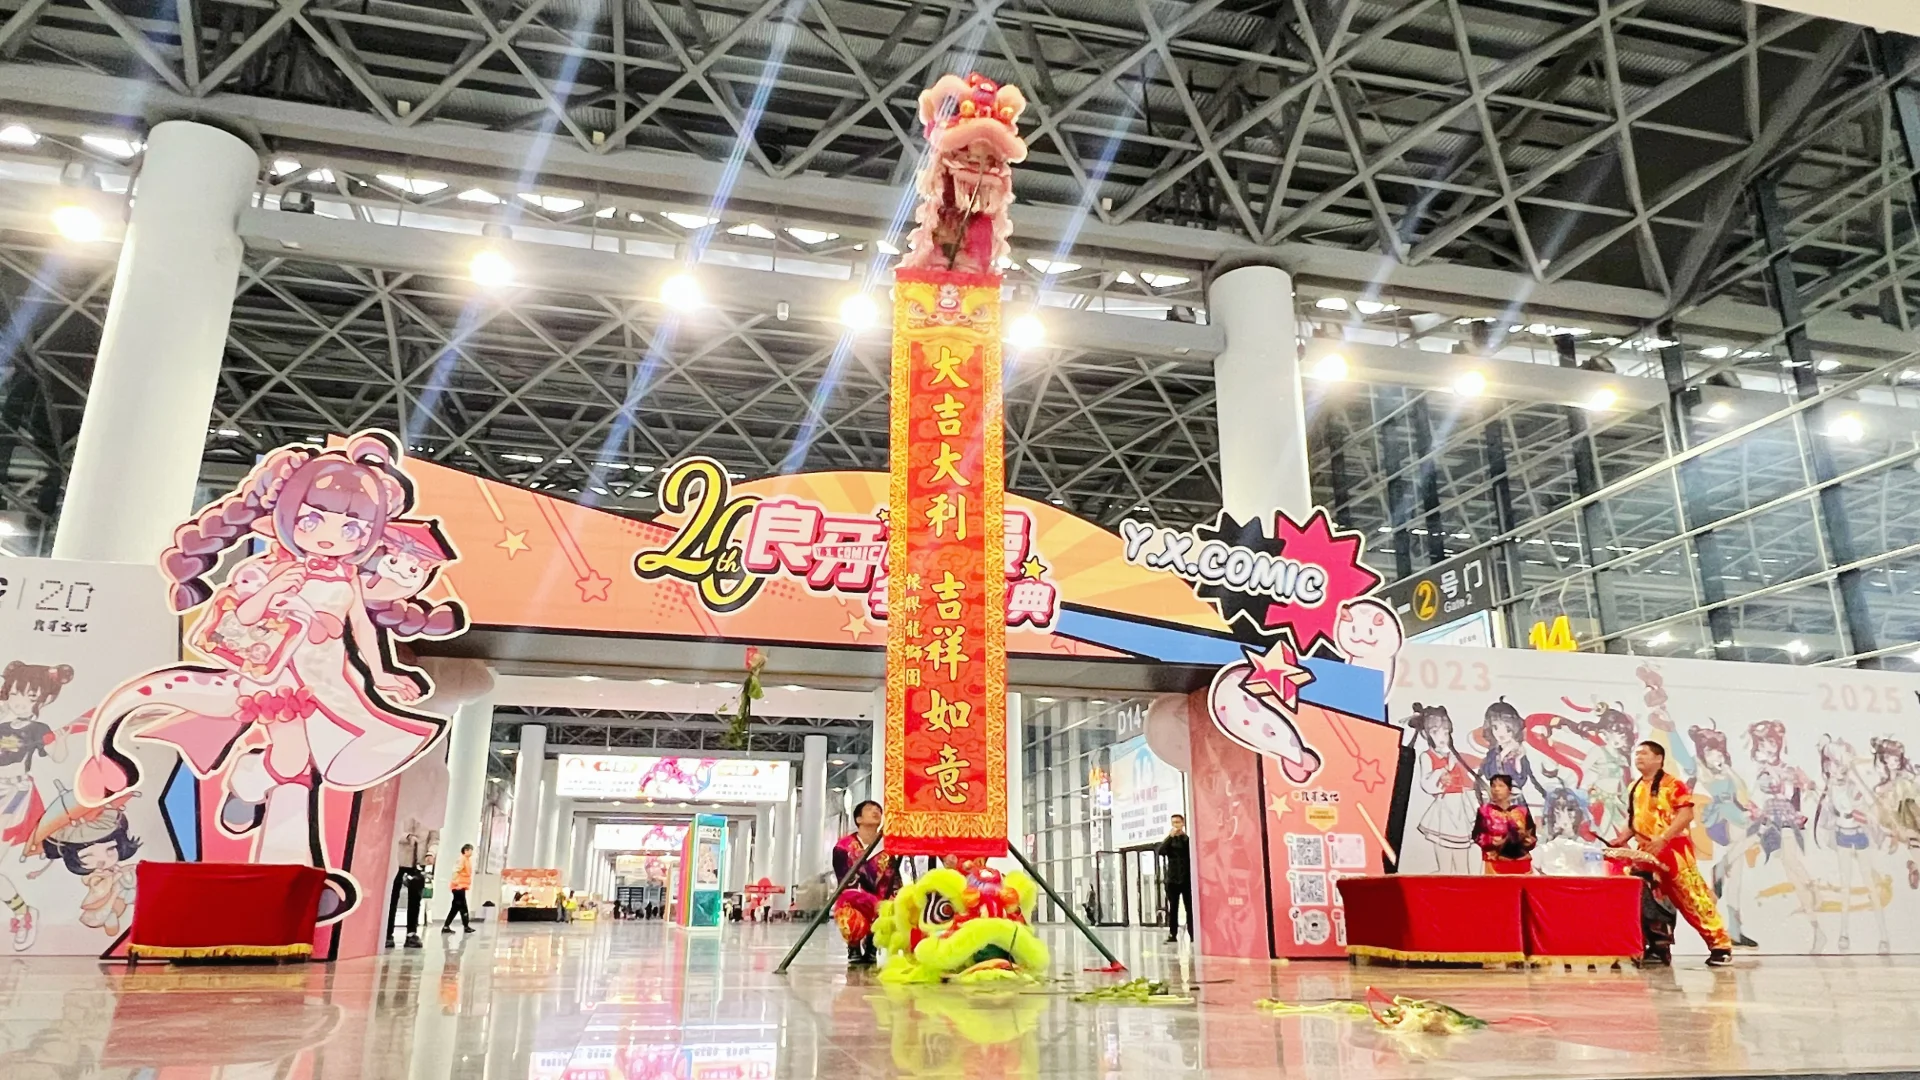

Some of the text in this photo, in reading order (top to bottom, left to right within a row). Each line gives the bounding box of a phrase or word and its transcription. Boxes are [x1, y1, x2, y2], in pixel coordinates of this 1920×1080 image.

[921, 345, 973, 805] 大吉大利 吉祥如意
[1123, 521, 1325, 604] Y.X.COMIC
[36, 580, 94, 612] 20
[1443, 593, 1473, 613] Gate 2
[1529, 615, 1577, 652] 14
[1395, 658, 1492, 692] 2023
[1817, 682, 1903, 714] 2025
